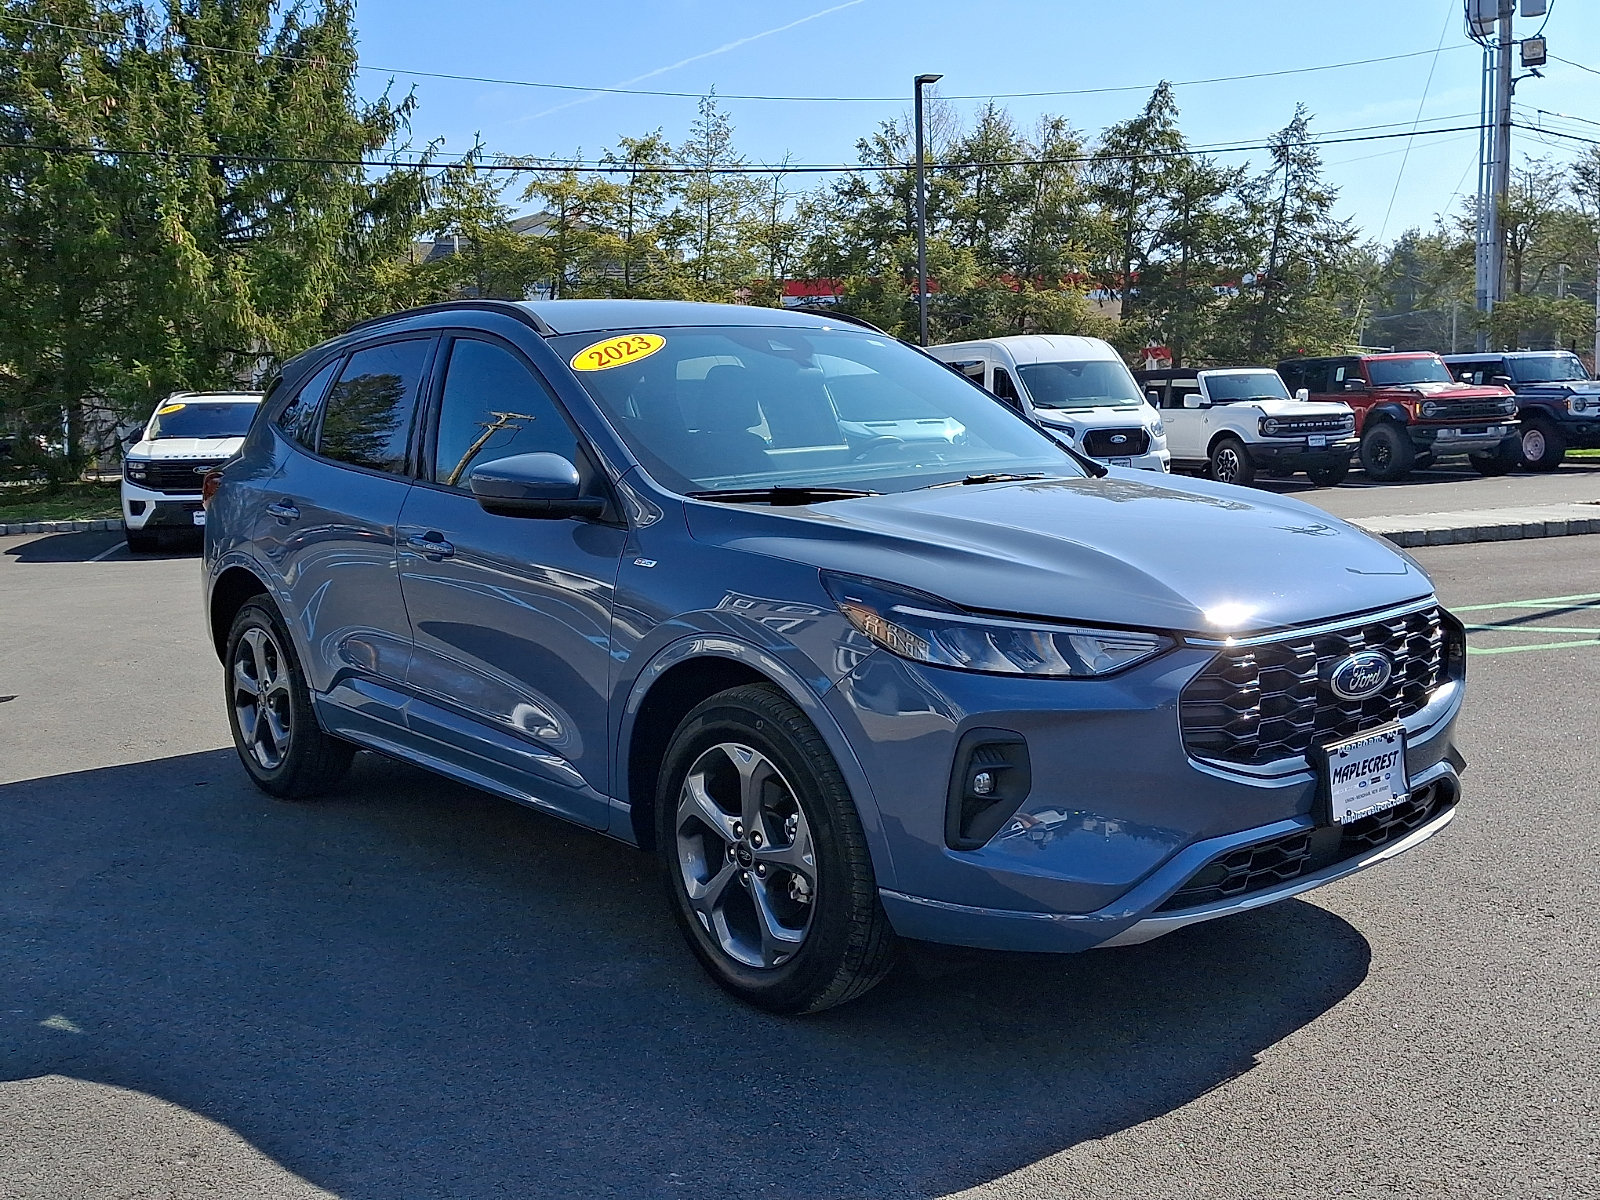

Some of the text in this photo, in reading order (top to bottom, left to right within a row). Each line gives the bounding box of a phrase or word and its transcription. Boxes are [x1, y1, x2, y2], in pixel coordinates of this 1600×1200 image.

[588, 336, 652, 367] 2023
[1349, 661, 1382, 691] Ford
[1332, 749, 1400, 786] MAPLECREST
